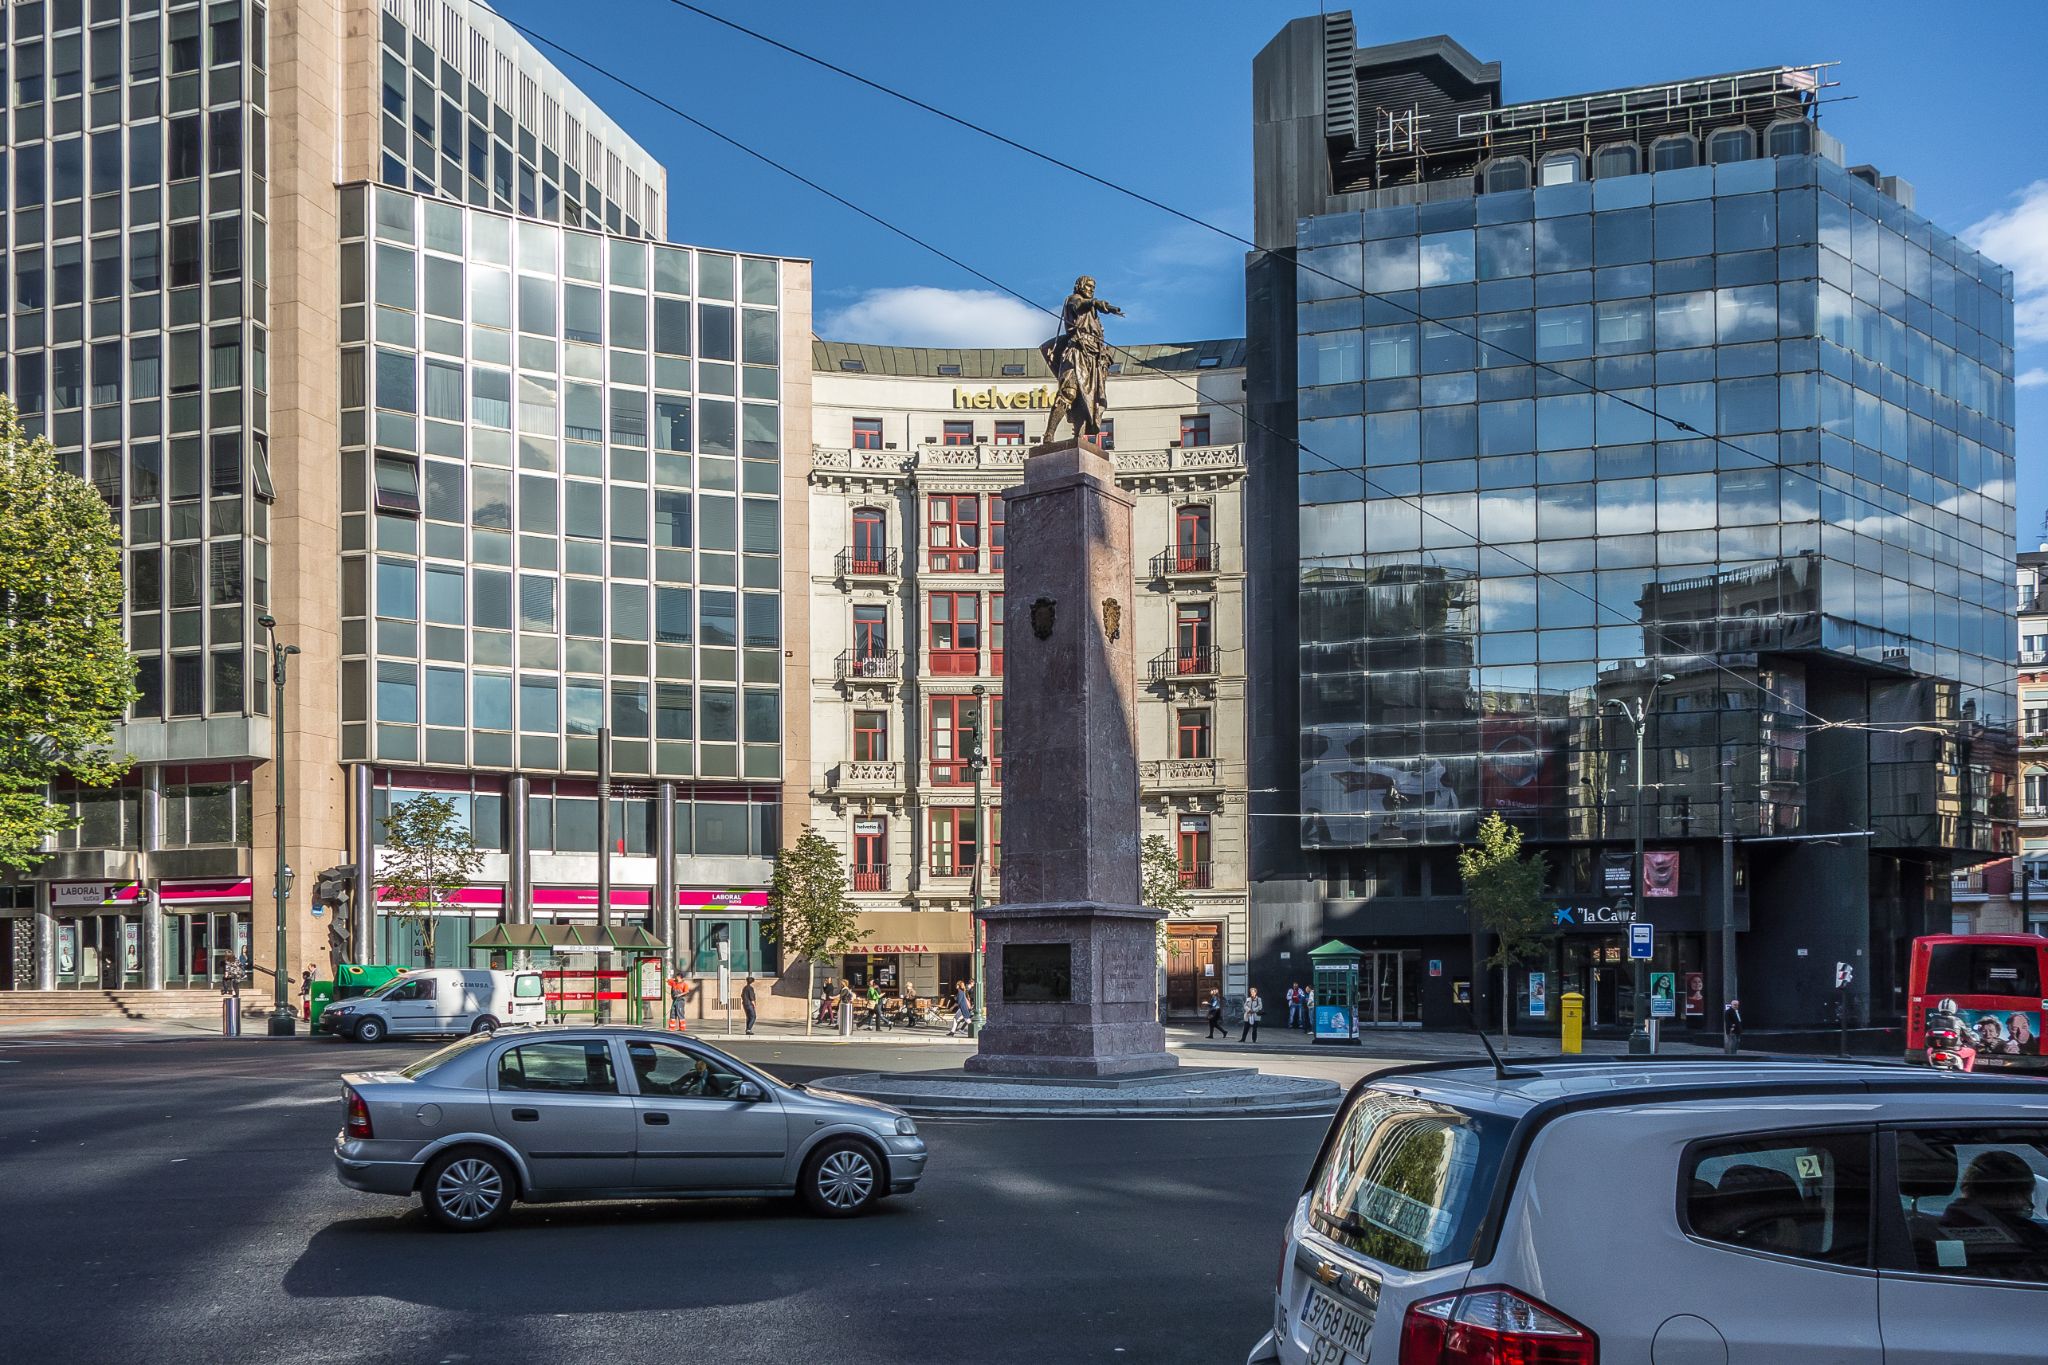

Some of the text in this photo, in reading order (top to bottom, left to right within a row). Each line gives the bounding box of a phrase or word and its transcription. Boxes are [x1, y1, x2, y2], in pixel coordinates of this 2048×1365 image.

[61, 887, 100, 896] LABORAL
[873, 944, 929, 953] GRANJA
[1801, 1158, 1817, 1177] 2
[1310, 1295, 1343, 1335] 3768
[1340, 1312, 1372, 1354] HHK
